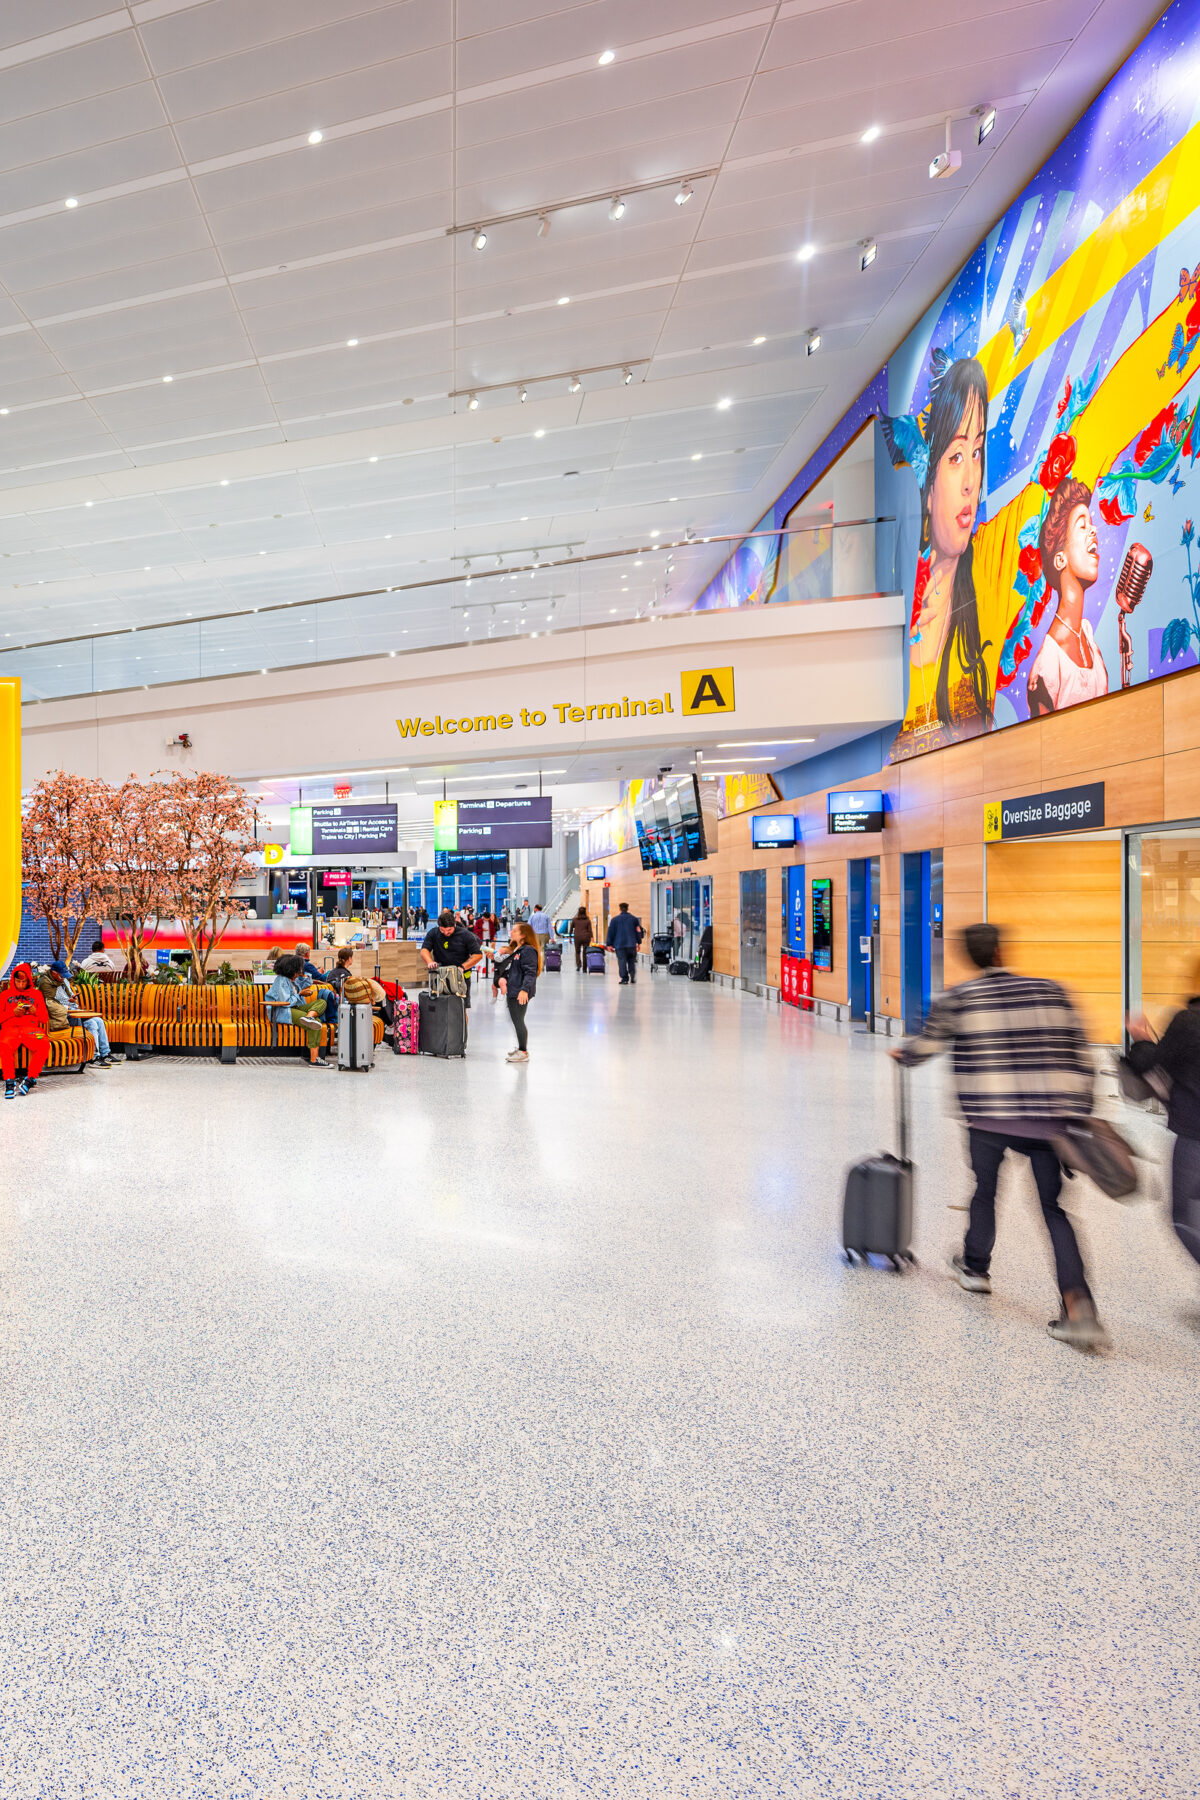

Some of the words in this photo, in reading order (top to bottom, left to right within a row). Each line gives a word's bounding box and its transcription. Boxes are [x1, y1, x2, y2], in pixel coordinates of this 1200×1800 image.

[396, 711, 513, 738] Welcome
[520, 708, 547, 727] to
[553, 692, 674, 724] Terminal
[690, 674, 726, 709] A
[1003, 806, 1042, 825] Oversize
[1044, 800, 1091, 820] Baggage
[298, 870, 305, 879] 3
